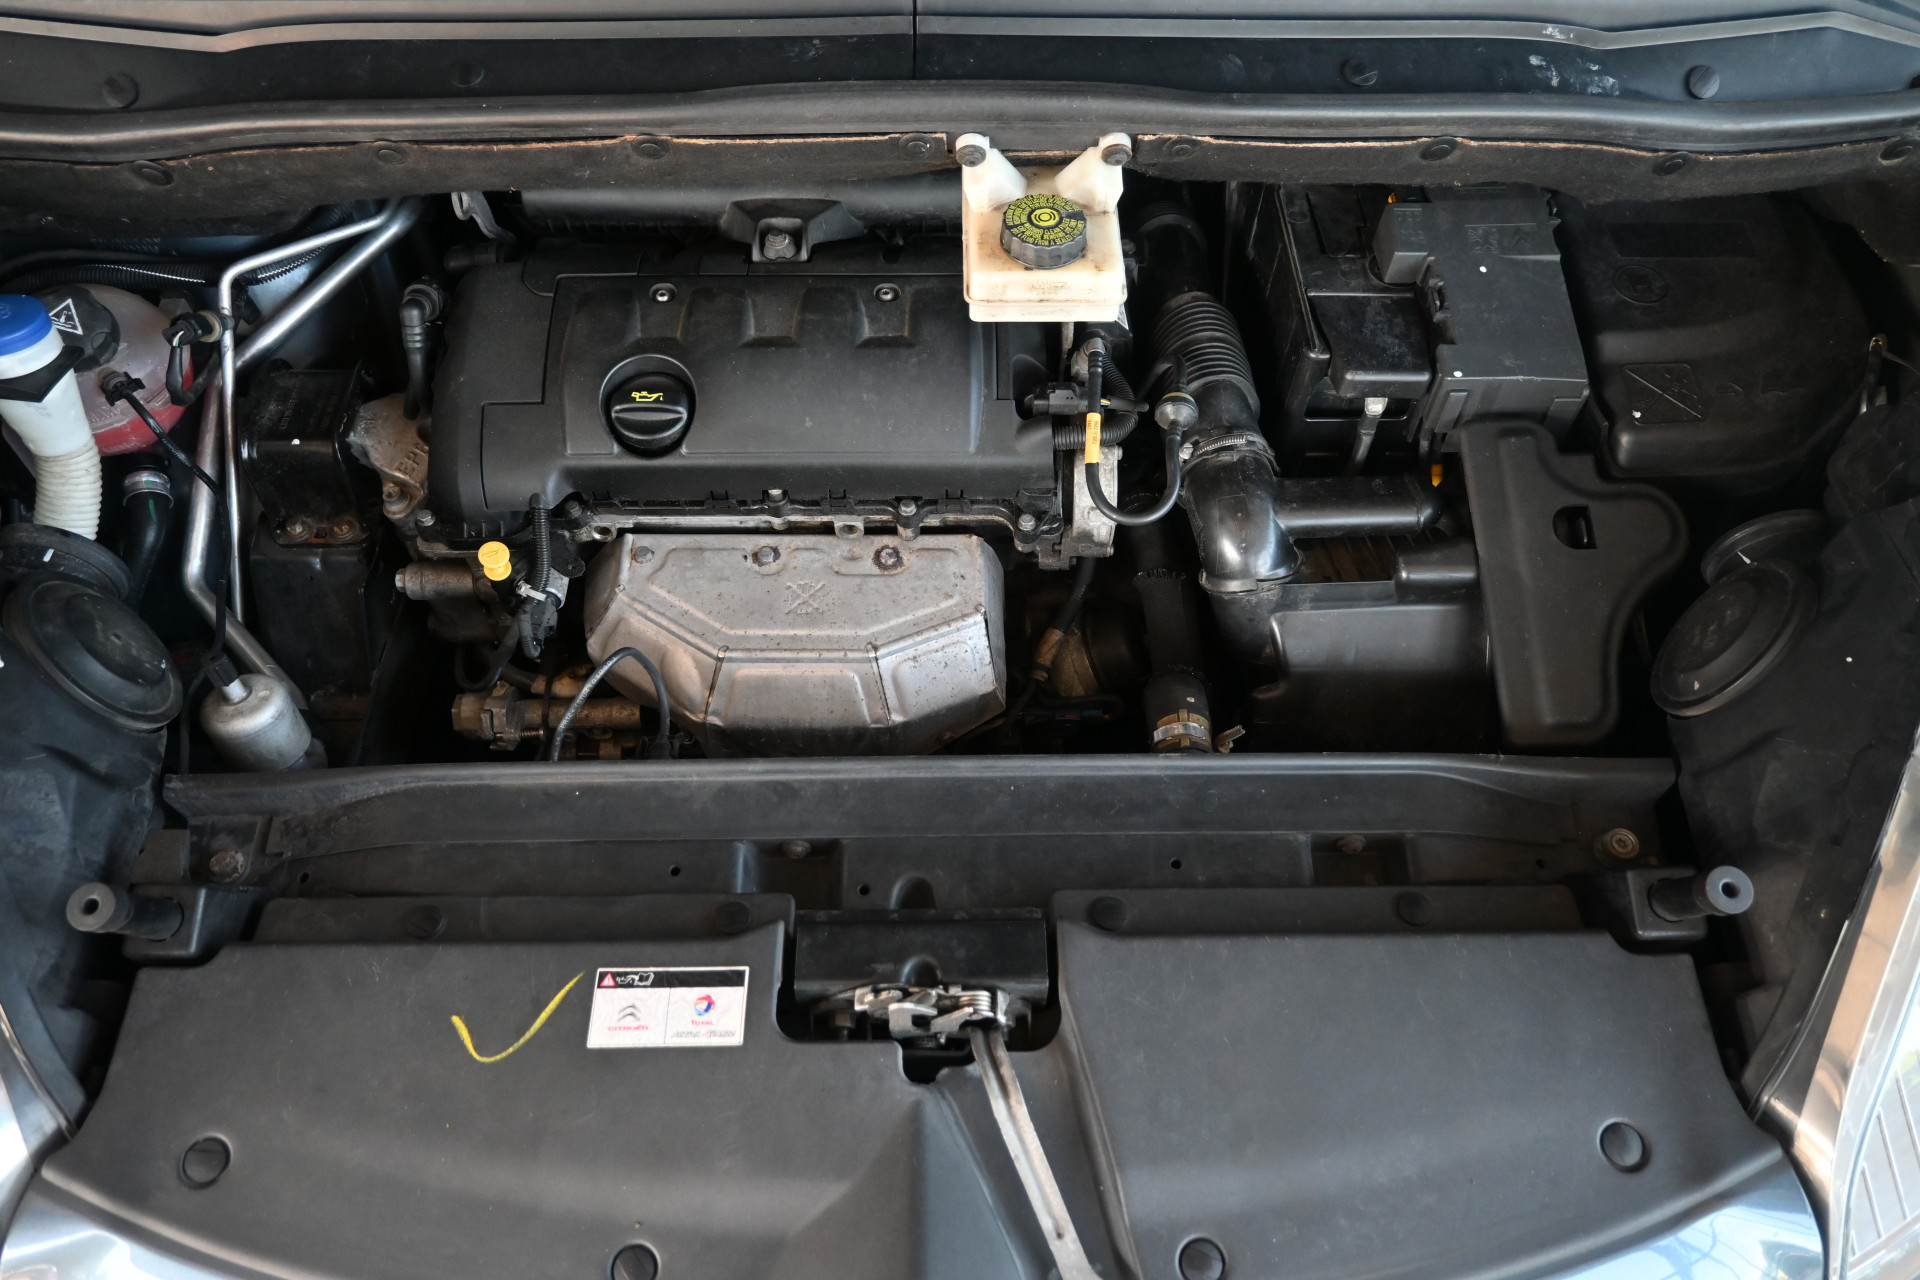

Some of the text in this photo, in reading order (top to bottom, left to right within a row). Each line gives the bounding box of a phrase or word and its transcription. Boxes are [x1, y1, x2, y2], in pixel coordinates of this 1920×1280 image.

[1044, 227, 1061, 235] CLEAN
[1020, 234, 1035, 243] FLUID
[1034, 238, 1049, 246] FROM
[1055, 234, 1073, 245] SEALED
[691, 1019, 716, 1027] TOTAL
